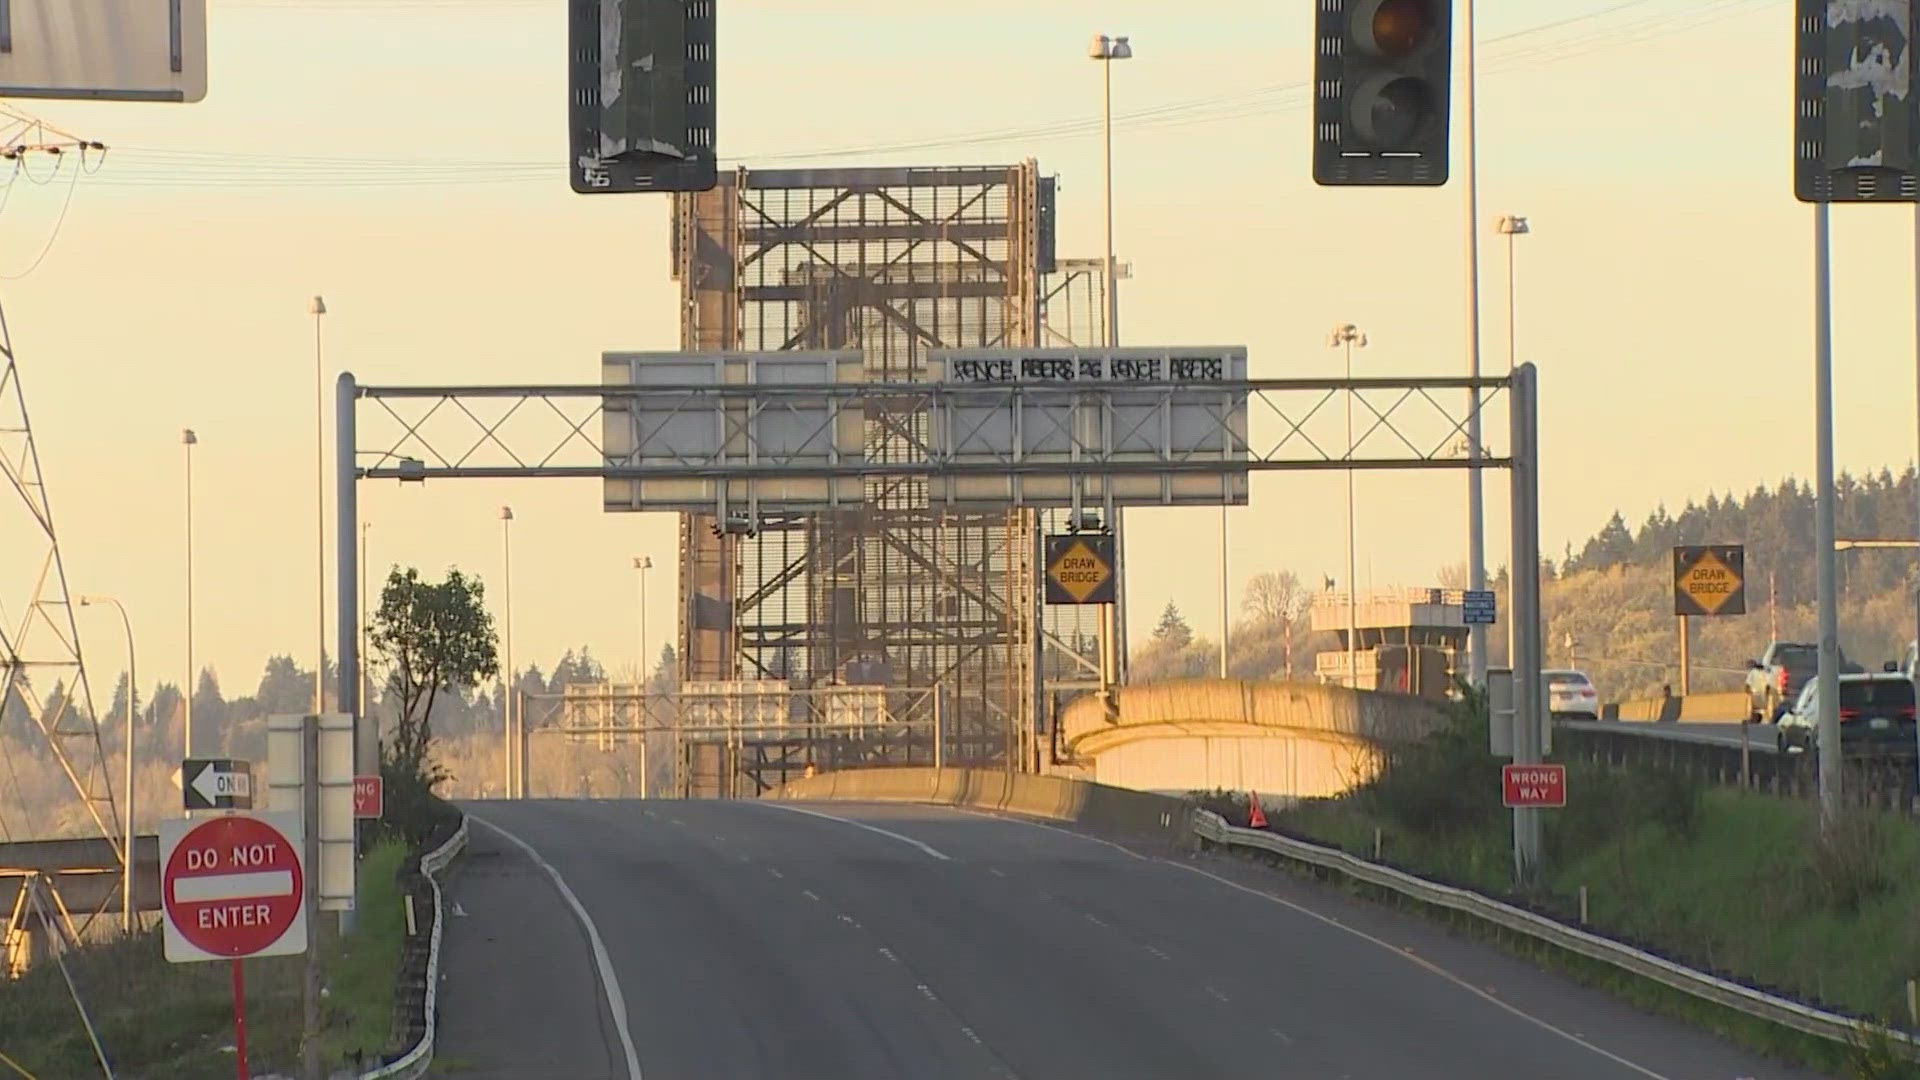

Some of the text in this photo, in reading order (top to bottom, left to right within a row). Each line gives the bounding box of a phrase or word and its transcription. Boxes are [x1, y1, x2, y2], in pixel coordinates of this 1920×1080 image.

[1063, 558, 1095, 569] DRAW
[1060, 571, 1099, 583] BRIDGE
[1693, 568, 1725, 580] DRAW
[1690, 582, 1729, 594] BRIDGE
[1511, 771, 1558, 785] WRONG
[1520, 787, 1548, 800] WAY
[187, 844, 276, 870] DO NOT
[198, 904, 271, 929] ENTER
